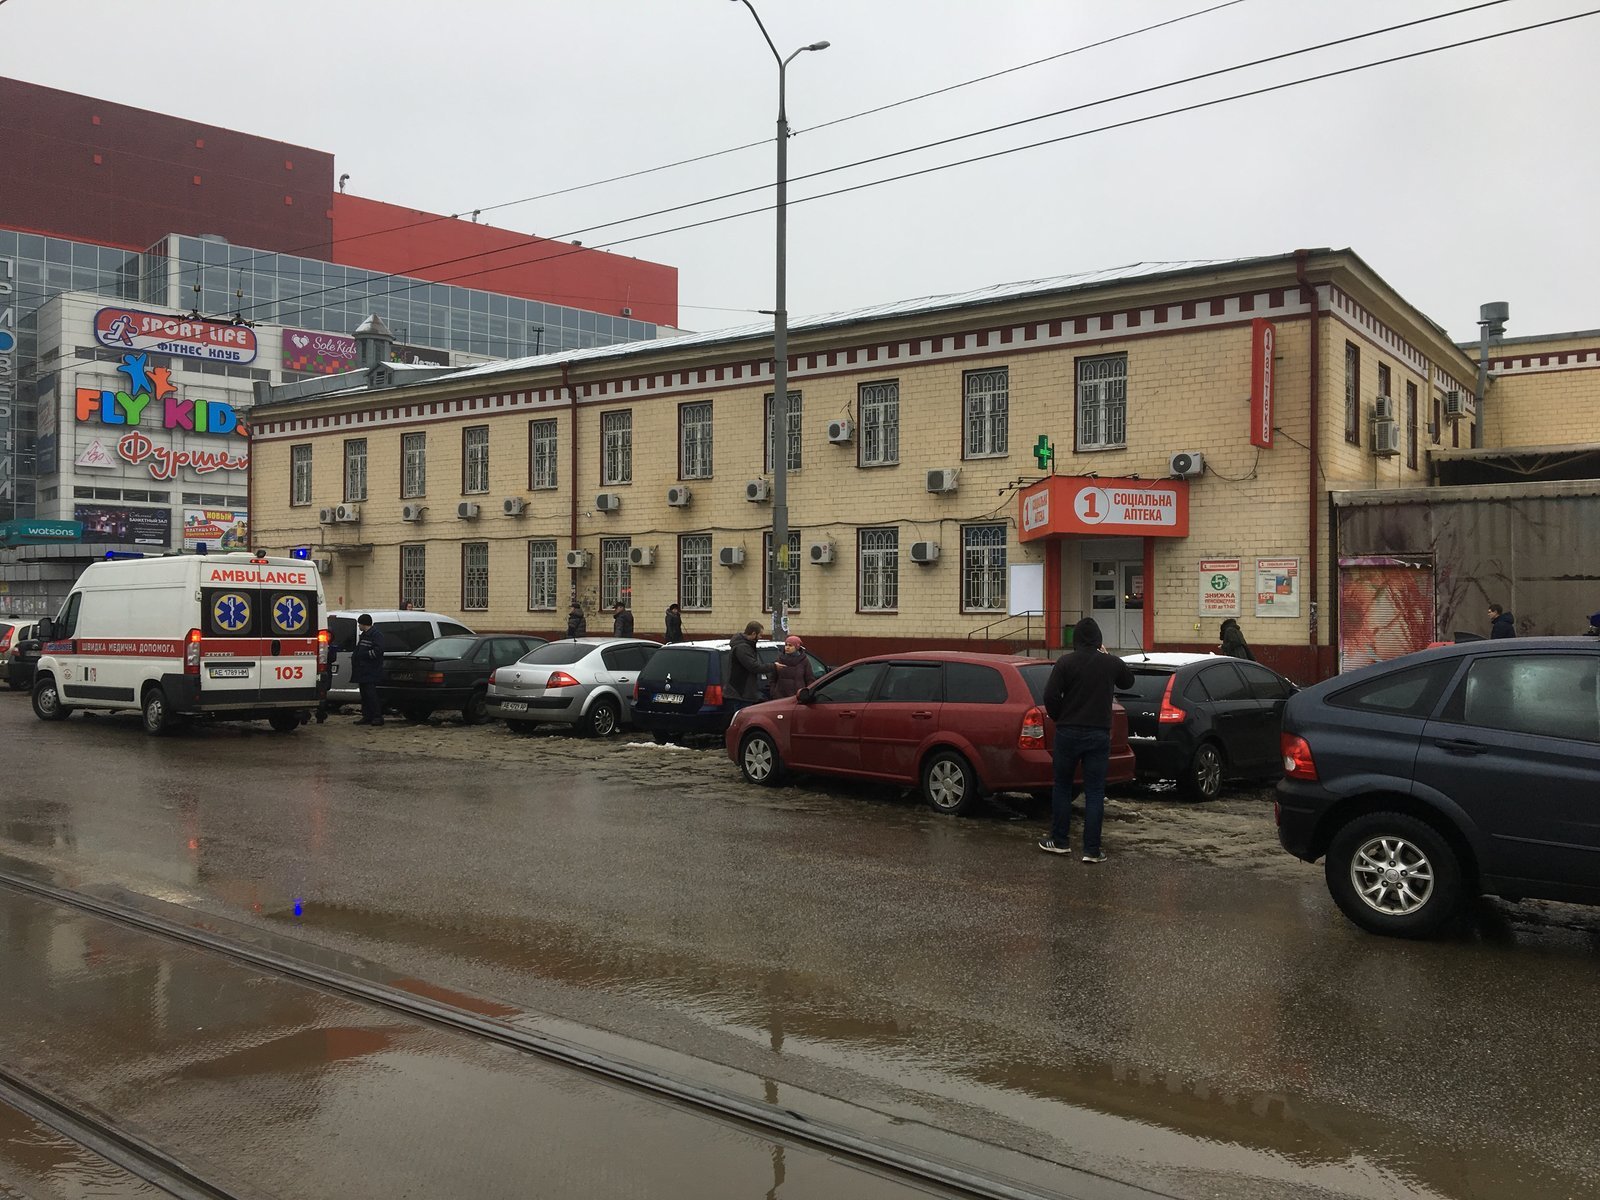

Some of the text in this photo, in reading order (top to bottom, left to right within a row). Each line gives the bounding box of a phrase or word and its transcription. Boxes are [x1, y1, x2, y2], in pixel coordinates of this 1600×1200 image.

[141, 317, 247, 345] SPORT LIFE
[157, 342, 241, 360] ФІТНЕС КЛУБ
[312, 336, 357, 359] Sole Kids
[75, 387, 151, 426] FLY
[1084, 492, 1100, 518] 1
[1113, 492, 1173, 507] СОЦІАЛЬНА
[1123, 508, 1163, 521] АПТЕКА
[28, 527, 75, 536] watsons
[210, 569, 307, 585] AMBULANCE
[81, 642, 107, 652] ШВИДКА
[108, 643, 137, 652] МЕДИЧНА
[139, 643, 175, 653] ДОПОМОГА
[275, 666, 303, 680] 103
